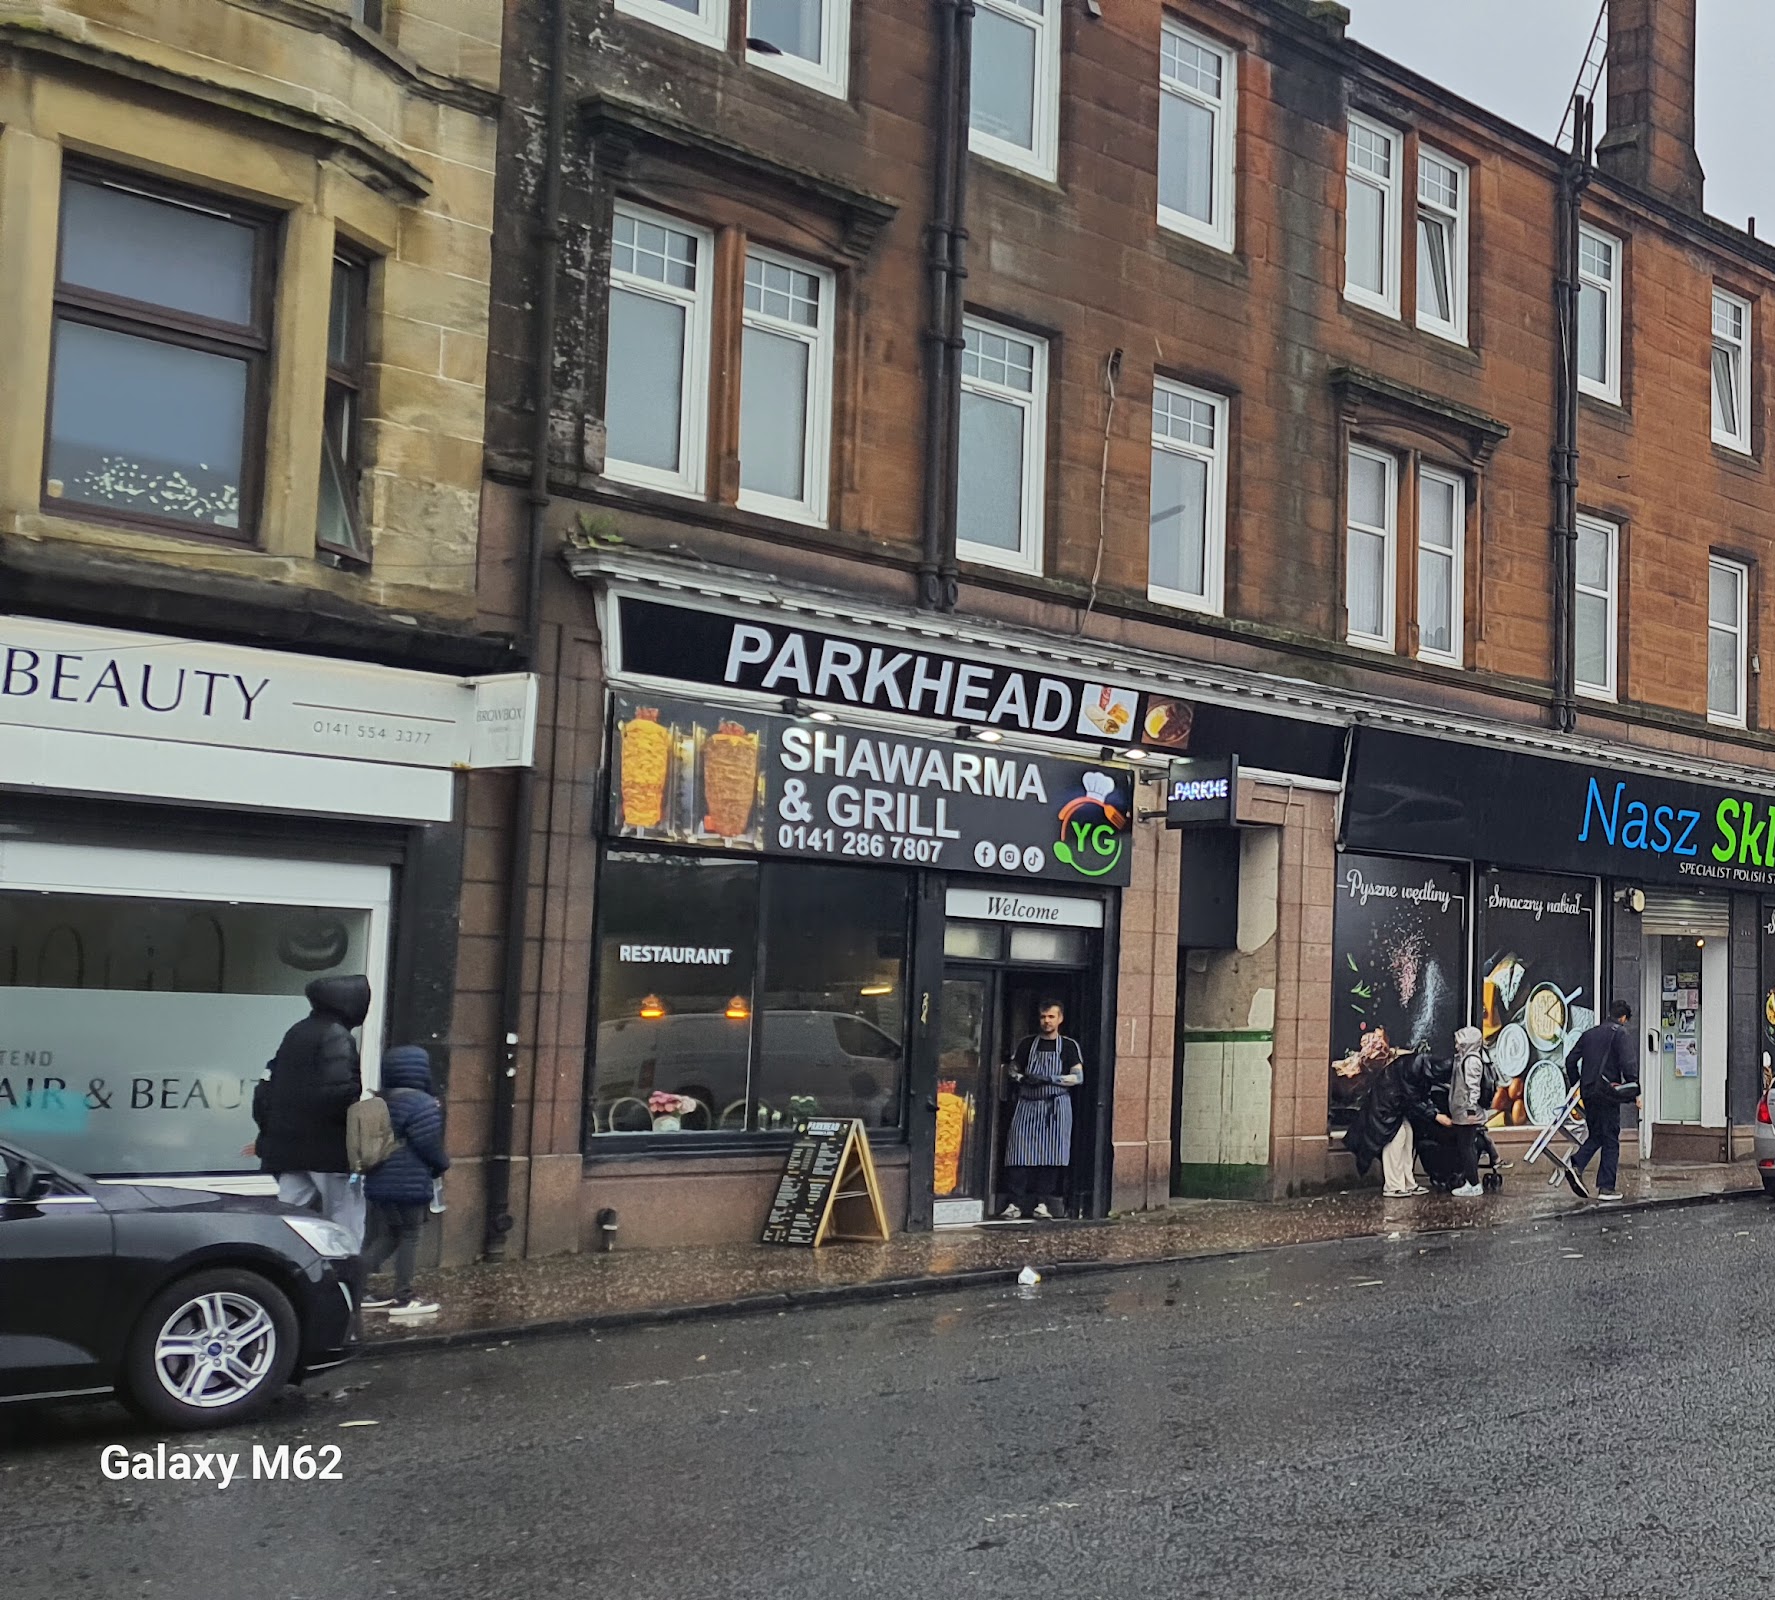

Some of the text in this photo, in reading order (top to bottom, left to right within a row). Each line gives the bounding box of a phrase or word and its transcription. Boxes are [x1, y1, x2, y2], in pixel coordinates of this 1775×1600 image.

[2, 647, 270, 721] BEAUTY
[724, 623, 1073, 733] PARKHEAD
[313, 721, 431, 745] 0141 554 3377
[779, 726, 1048, 803] SHAWARMA
[1174, 778, 1229, 801] PARKHE
[778, 778, 960, 840] & GRILL
[1578, 777, 1700, 856] Nasz
[778, 824, 943, 864] 0141 286 7807
[1070, 820, 1117, 856] YG
[1347, 868, 1451, 912] Pyszne wędliny
[1679, 861, 1732, 879] SPECIALIST
[1733, 868, 1766, 883] POLISH
[987, 896, 1059, 921] Welcome
[1488, 884, 1545, 921] Smaczny
[619, 944, 733, 965] RESTAURANT
[84, 1077, 113, 1110] &
